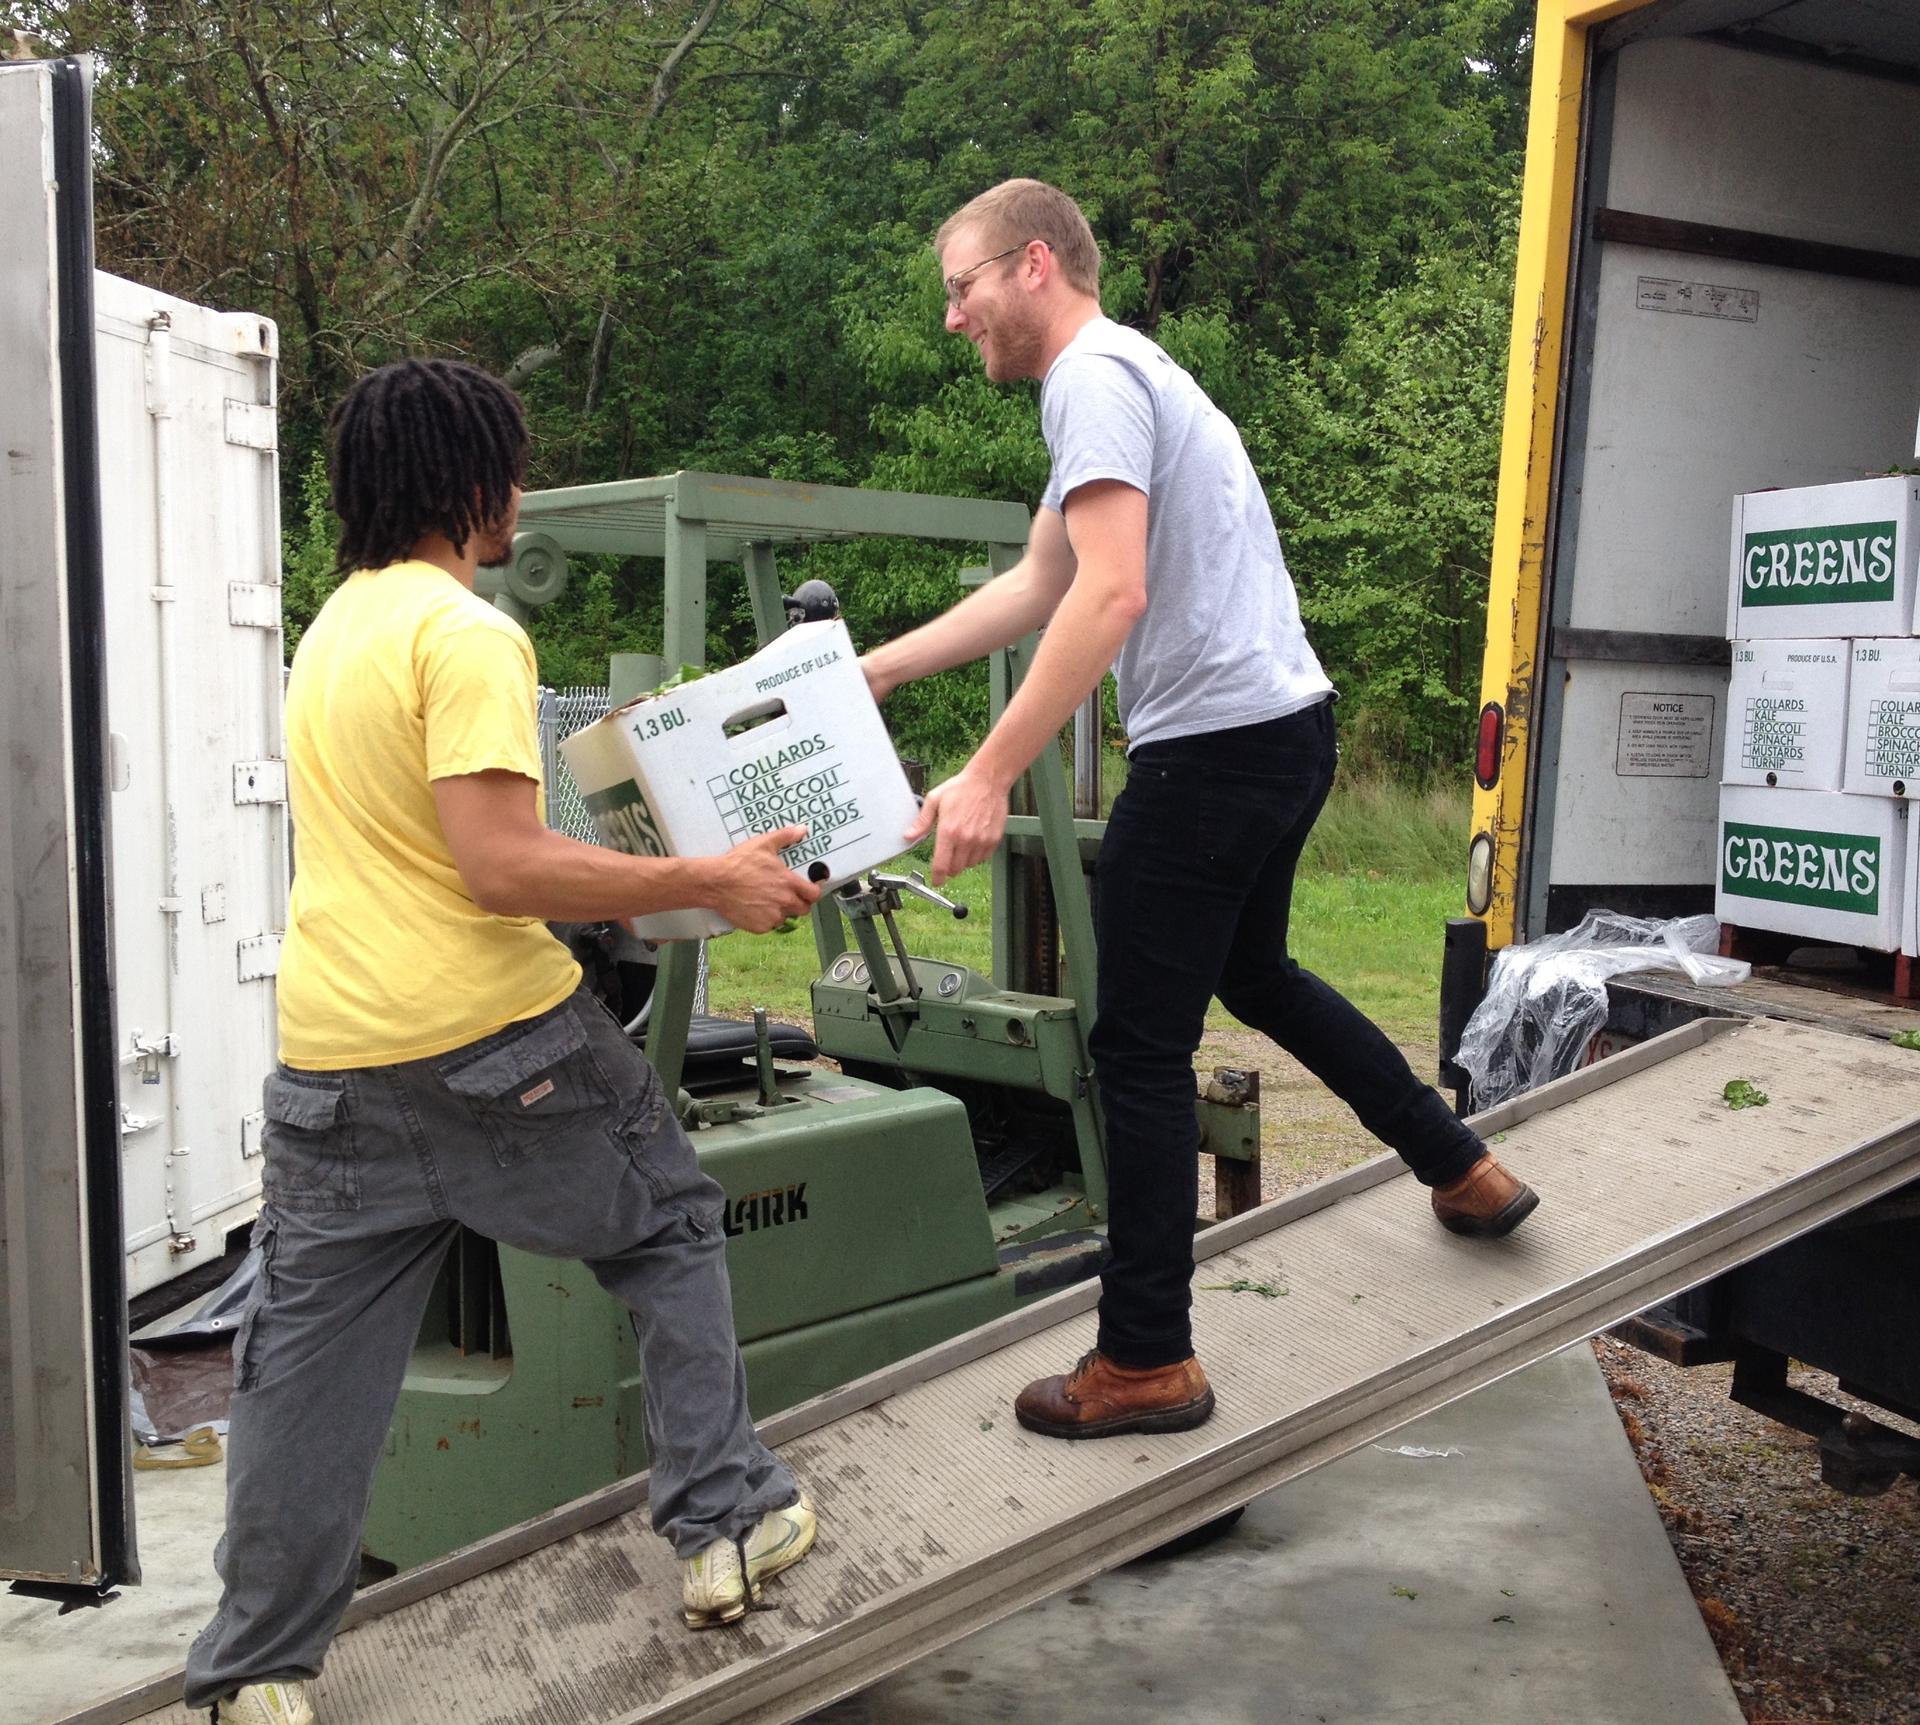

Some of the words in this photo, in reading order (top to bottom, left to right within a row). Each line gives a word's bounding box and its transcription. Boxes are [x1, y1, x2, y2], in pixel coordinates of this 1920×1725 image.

[1745, 536, 1892, 589] GREENS
[1787, 654, 1812, 663] PRODUCE
[1812, 654, 1820, 663] OF
[1820, 655, 1837, 664] U.S.A.
[1855, 650, 1867, 662] 1.3
[755, 666, 802, 693] PRODUCE
[802, 660, 814, 675] OF
[815, 650, 842, 668] U.S.A.
[1653, 703, 1684, 713] NOTICE
[1755, 698, 1804, 710] COLLARDS
[1881, 700, 1920, 712] COLLAR
[1754, 710, 1777, 721] KALE
[1879, 713, 1905, 725] KALE
[633, 718, 660, 742] 1.3
[659, 707, 692, 732] BU.
[1753, 722, 1801, 734] BROCCOLI
[1878, 726, 1920, 739] BROCCO
[1752, 734, 1794, 746] SPINACH
[1751, 746, 1804, 759] MUSTARDS
[1876, 751, 1920, 765] MUSTAR
[729, 733, 826, 786] COLLARDS
[1751, 757, 1785, 769] TURNIP
[1875, 764, 1915, 777] TURNIP
[735, 772, 784, 805] KALE
[743, 769, 839, 823] BROCCOLI
[751, 792, 836, 835] SPINACH
[1725, 835, 1876, 896] GREENS
[723, 1183, 808, 1238] LARK
